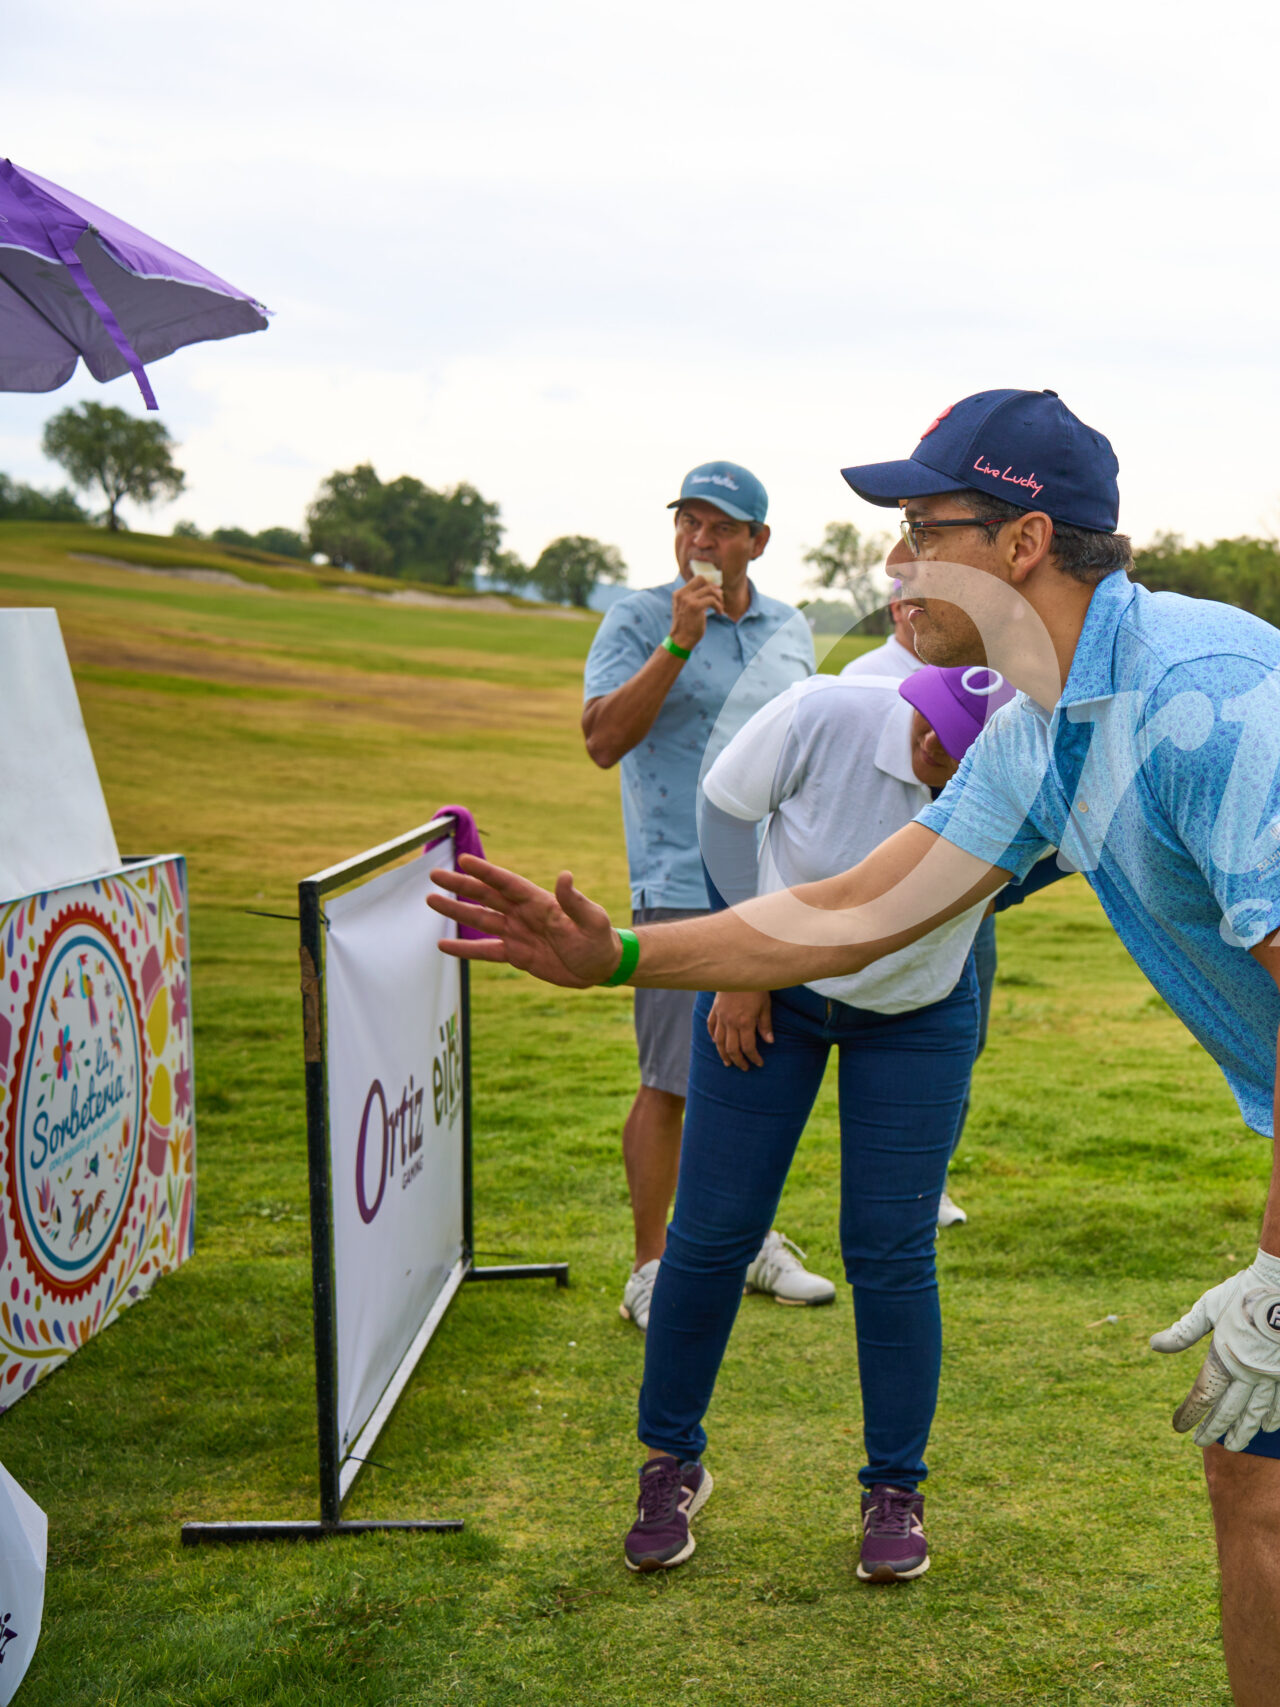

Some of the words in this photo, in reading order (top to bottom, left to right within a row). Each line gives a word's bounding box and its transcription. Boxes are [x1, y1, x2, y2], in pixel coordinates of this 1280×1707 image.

[973, 455, 1000, 479] Live
[1001, 466, 1044, 498] Lucky
[356, 1074, 424, 1224] Ortiz
[402, 1154, 424, 1190] GAMING
